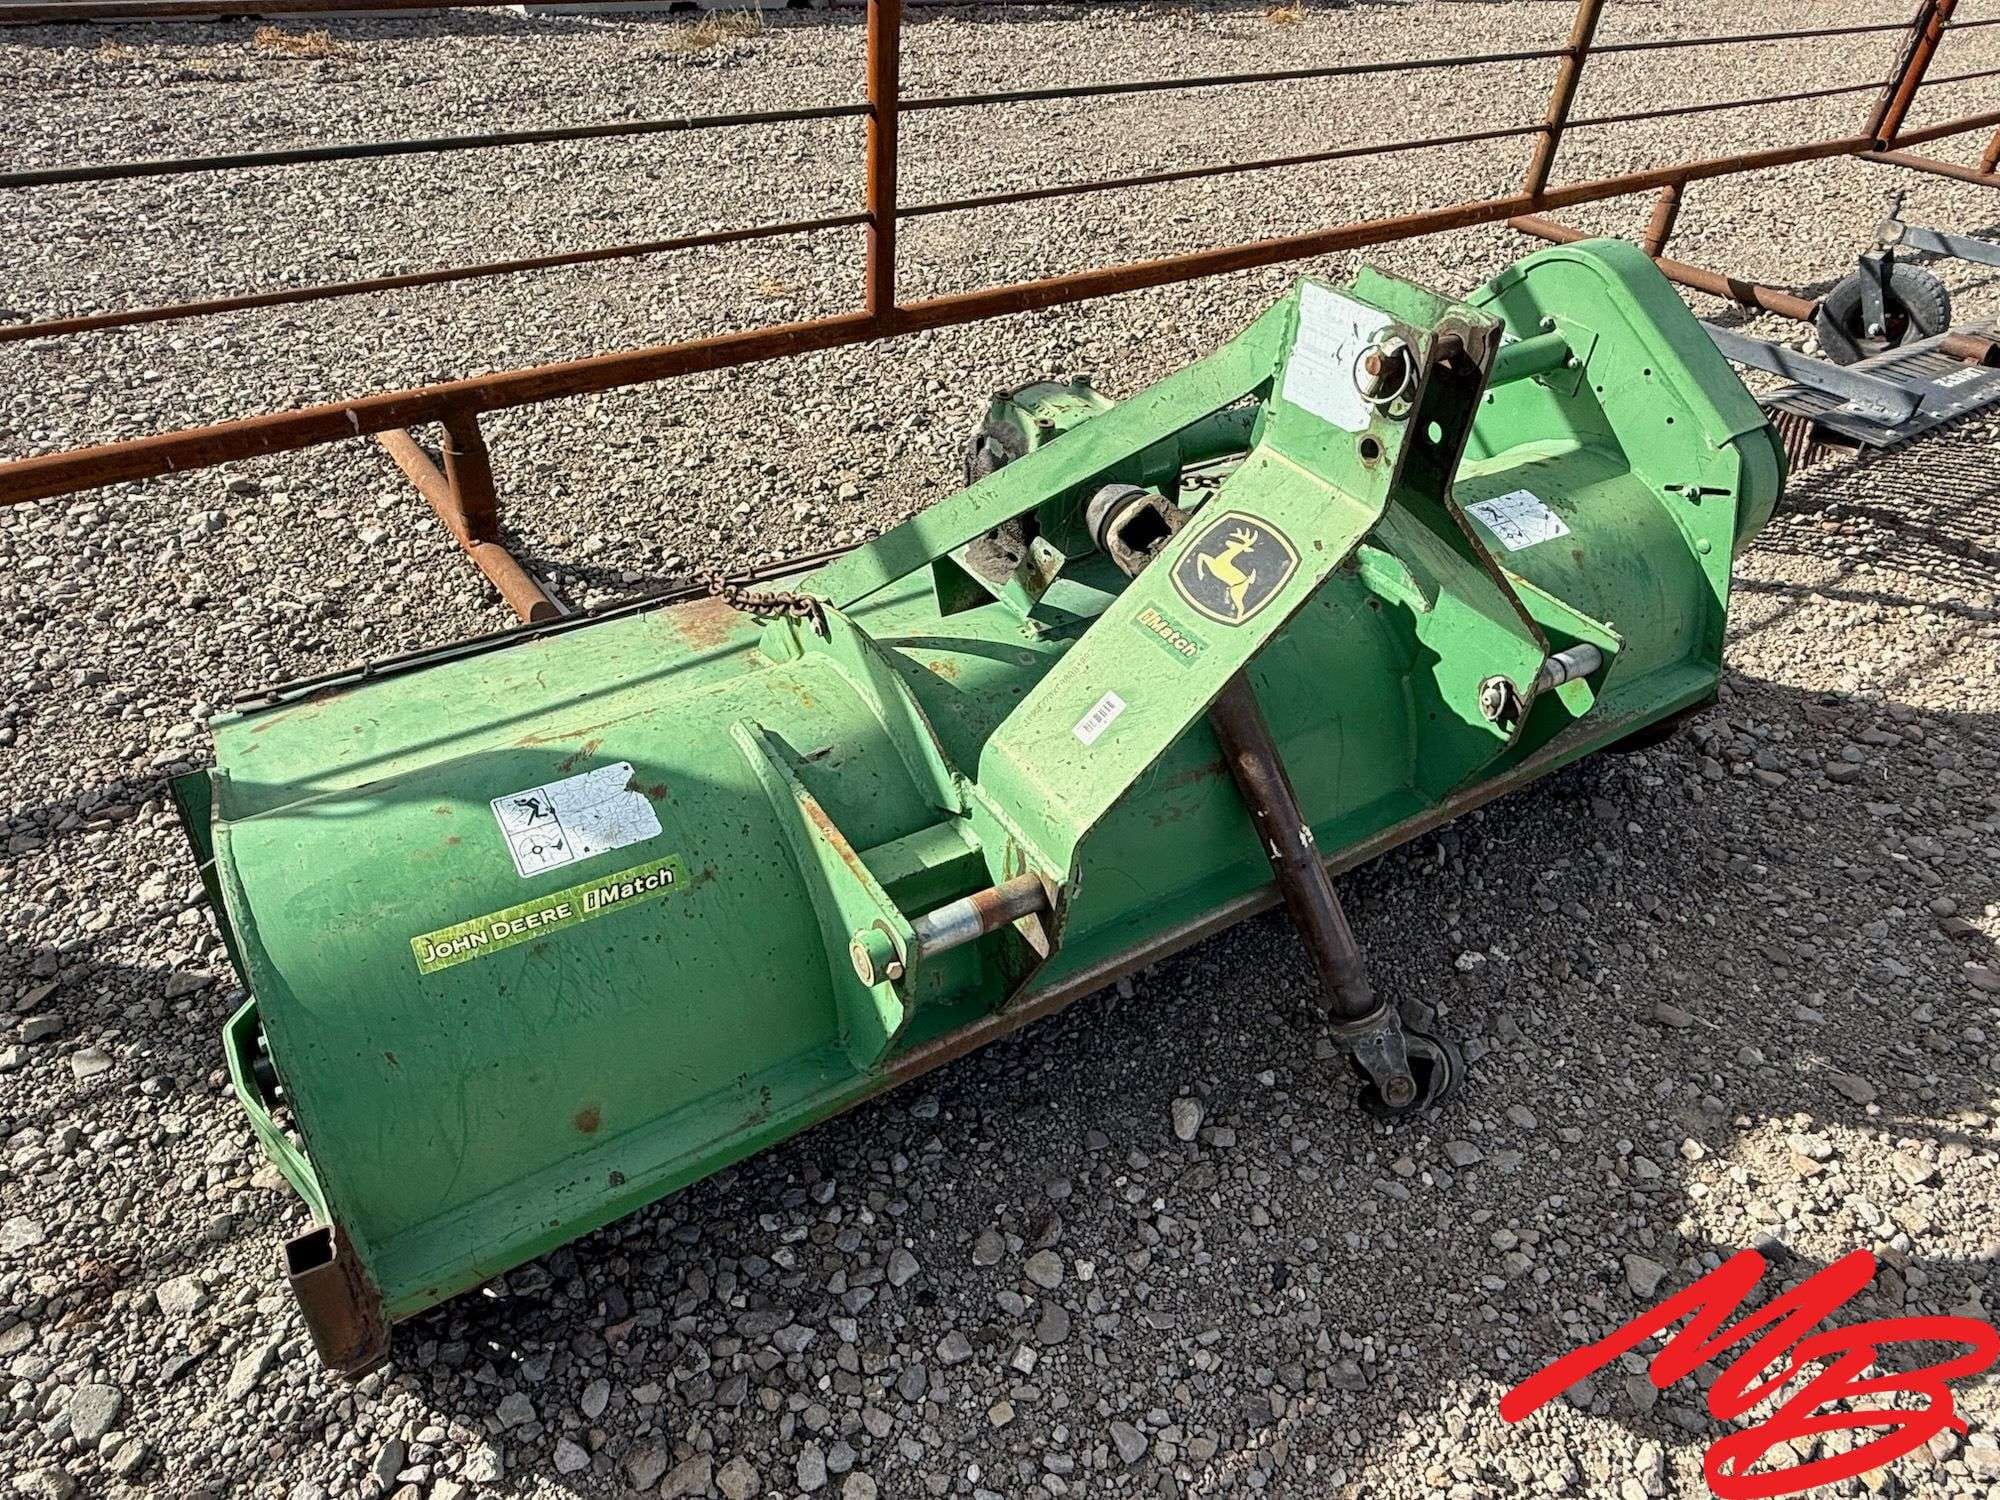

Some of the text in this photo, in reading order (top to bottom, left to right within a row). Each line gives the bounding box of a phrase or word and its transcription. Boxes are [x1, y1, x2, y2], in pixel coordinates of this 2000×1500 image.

[423, 866, 675, 964] JOHN DEERE iMatch
